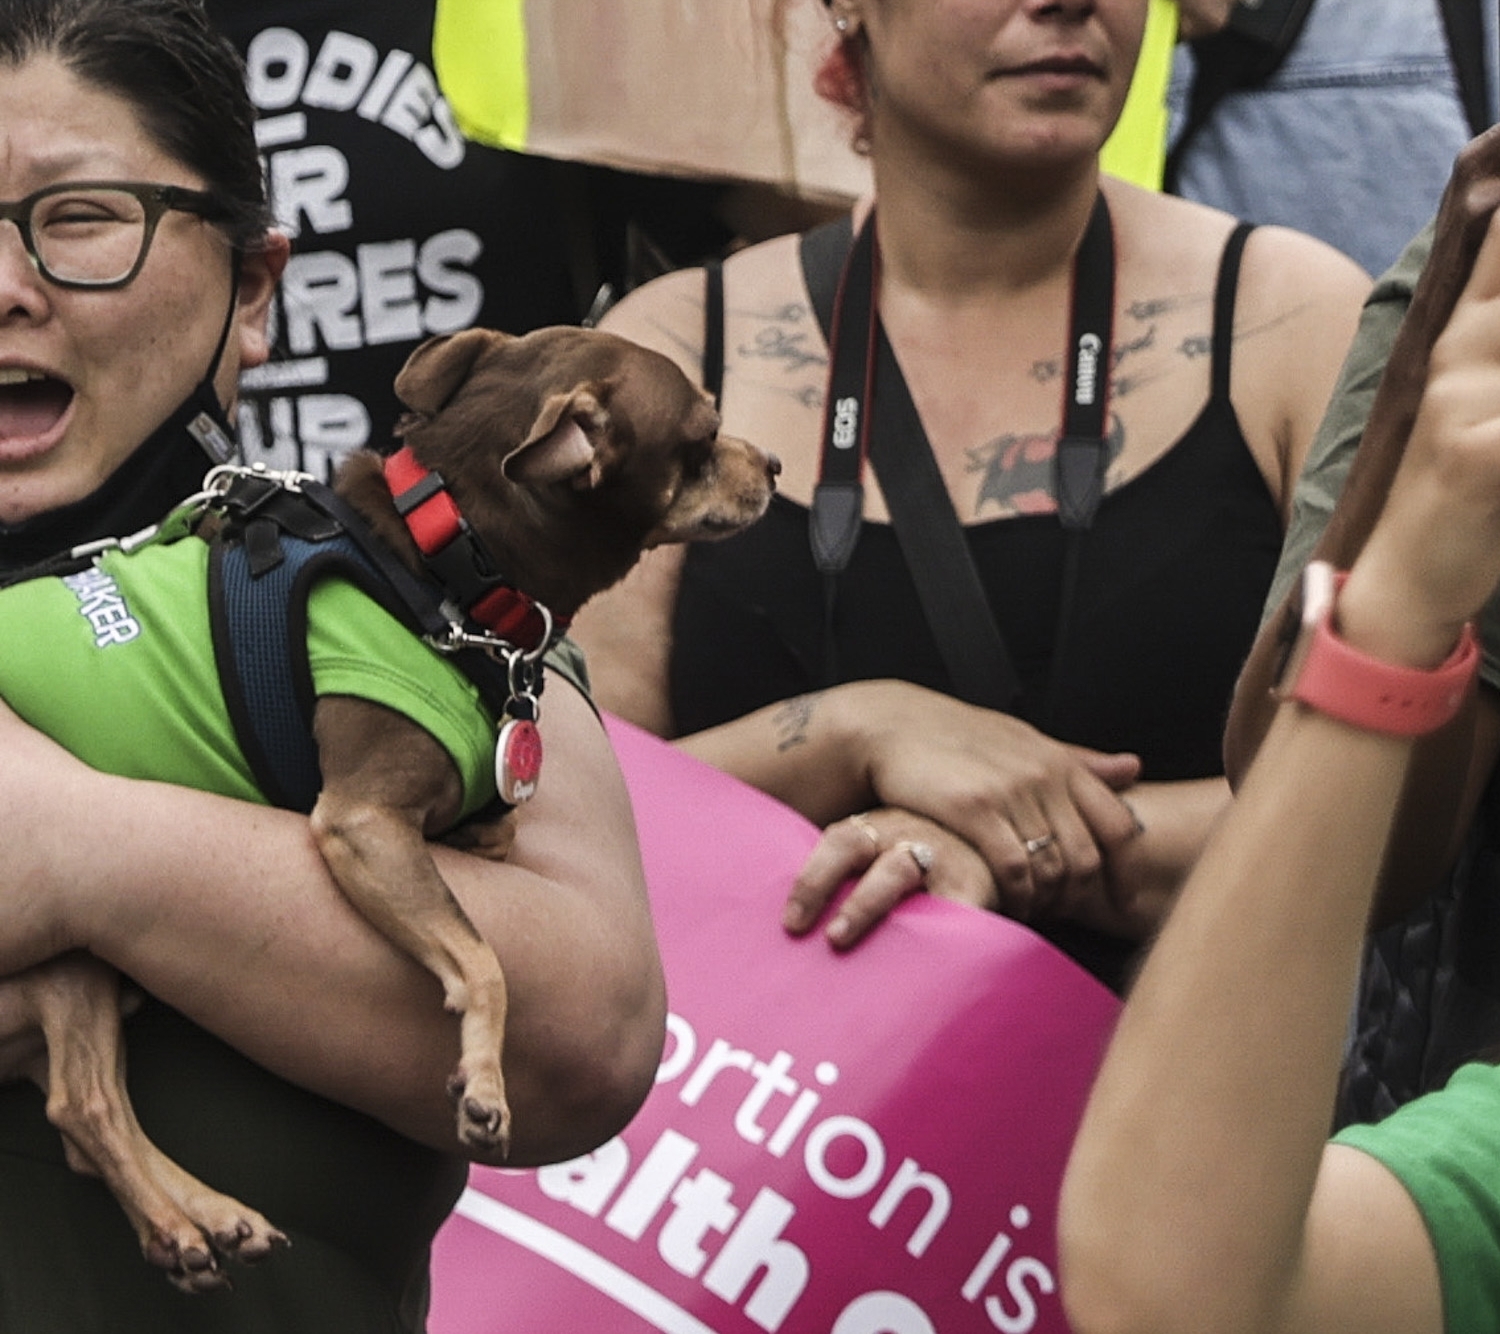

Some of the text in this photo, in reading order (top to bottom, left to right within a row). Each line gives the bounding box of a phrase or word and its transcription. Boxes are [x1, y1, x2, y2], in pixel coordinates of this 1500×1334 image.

[246, 27, 466, 169] ODIES
[833, 397, 858, 449] EOS
[536, 1127, 811, 1334] alth
[653, 1012, 1054, 1334] ortion is
